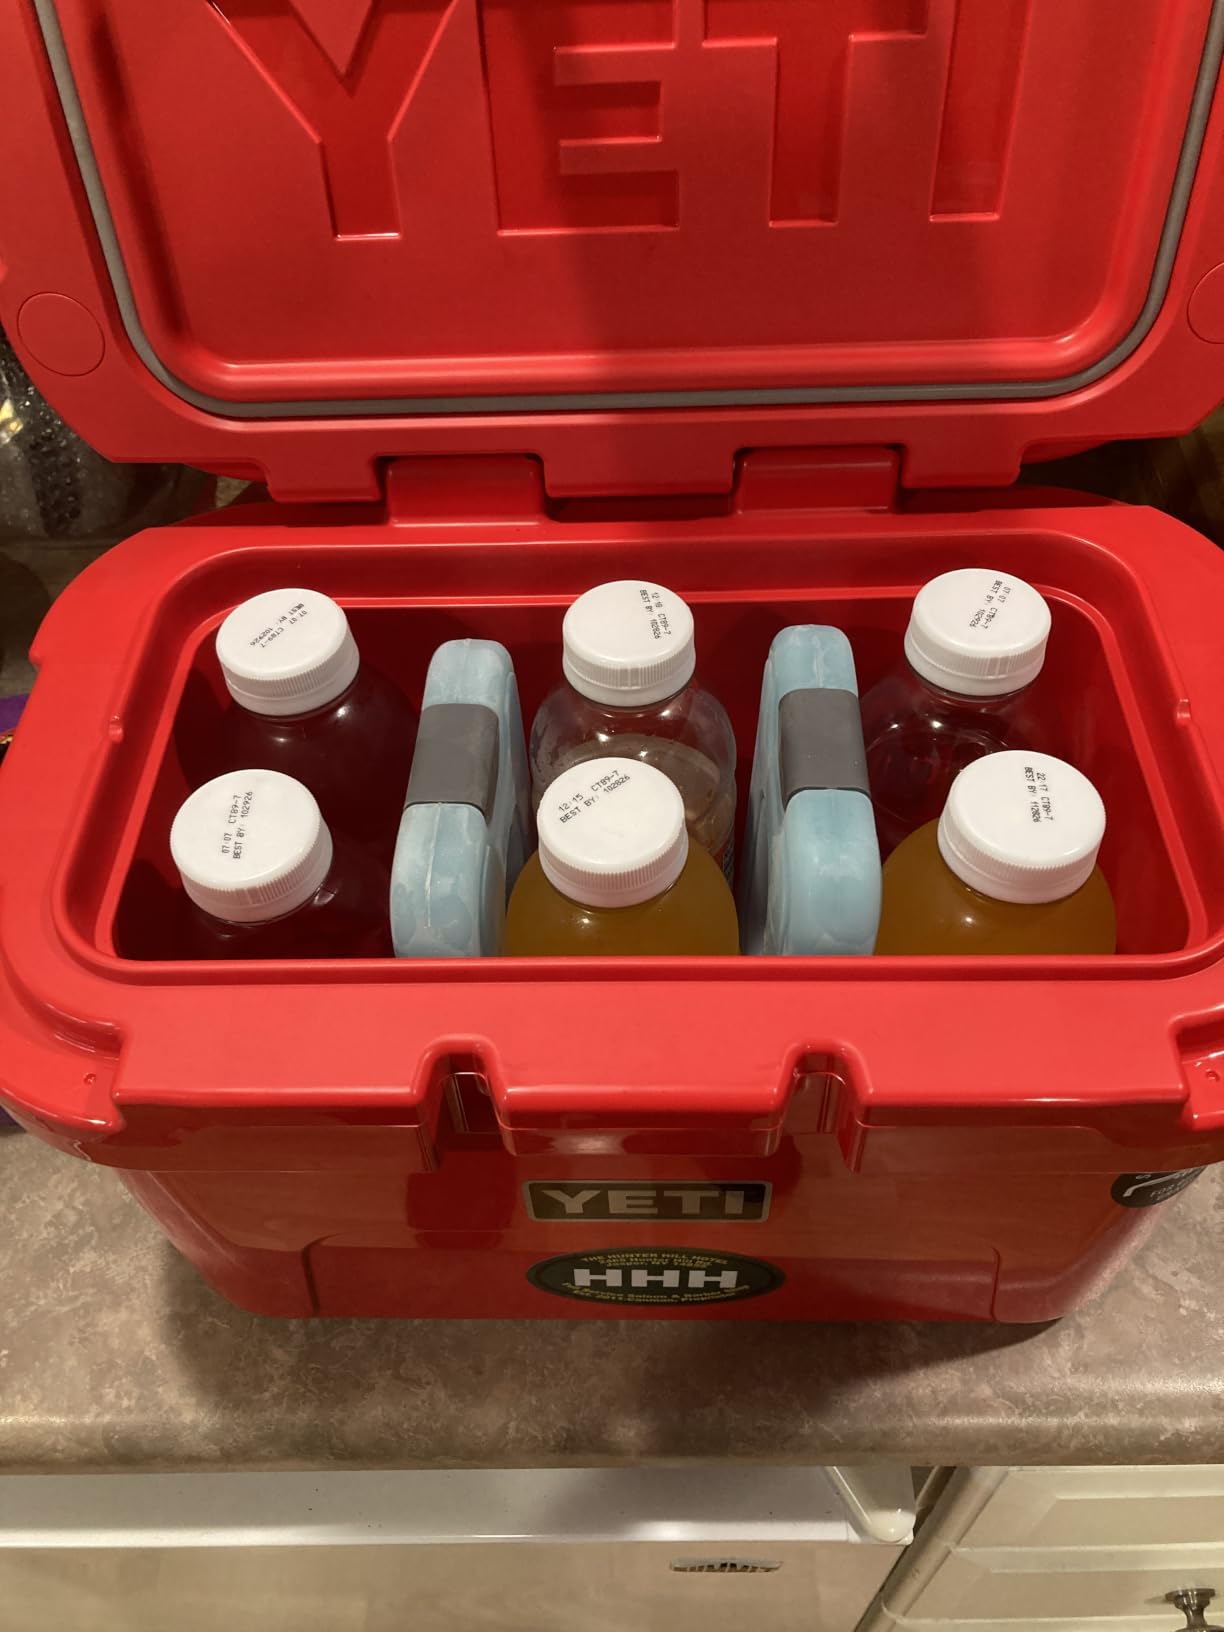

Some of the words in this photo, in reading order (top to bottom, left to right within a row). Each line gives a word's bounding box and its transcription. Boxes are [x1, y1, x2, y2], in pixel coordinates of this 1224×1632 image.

[208, 0, 1030, 241] YETI
[640, 589, 651, 603] BEST
[990, 580, 1002, 593] BEST
[1024, 766, 1035, 781] BEST
[559, 806, 581, 823] BEST
[603, 774, 631, 793] 102826
[232, 841, 243, 859] BEST
[240, 791, 253, 817] 102926
[541, 1190, 745, 1215] YETI
[573, 1268, 738, 1288] HHH
